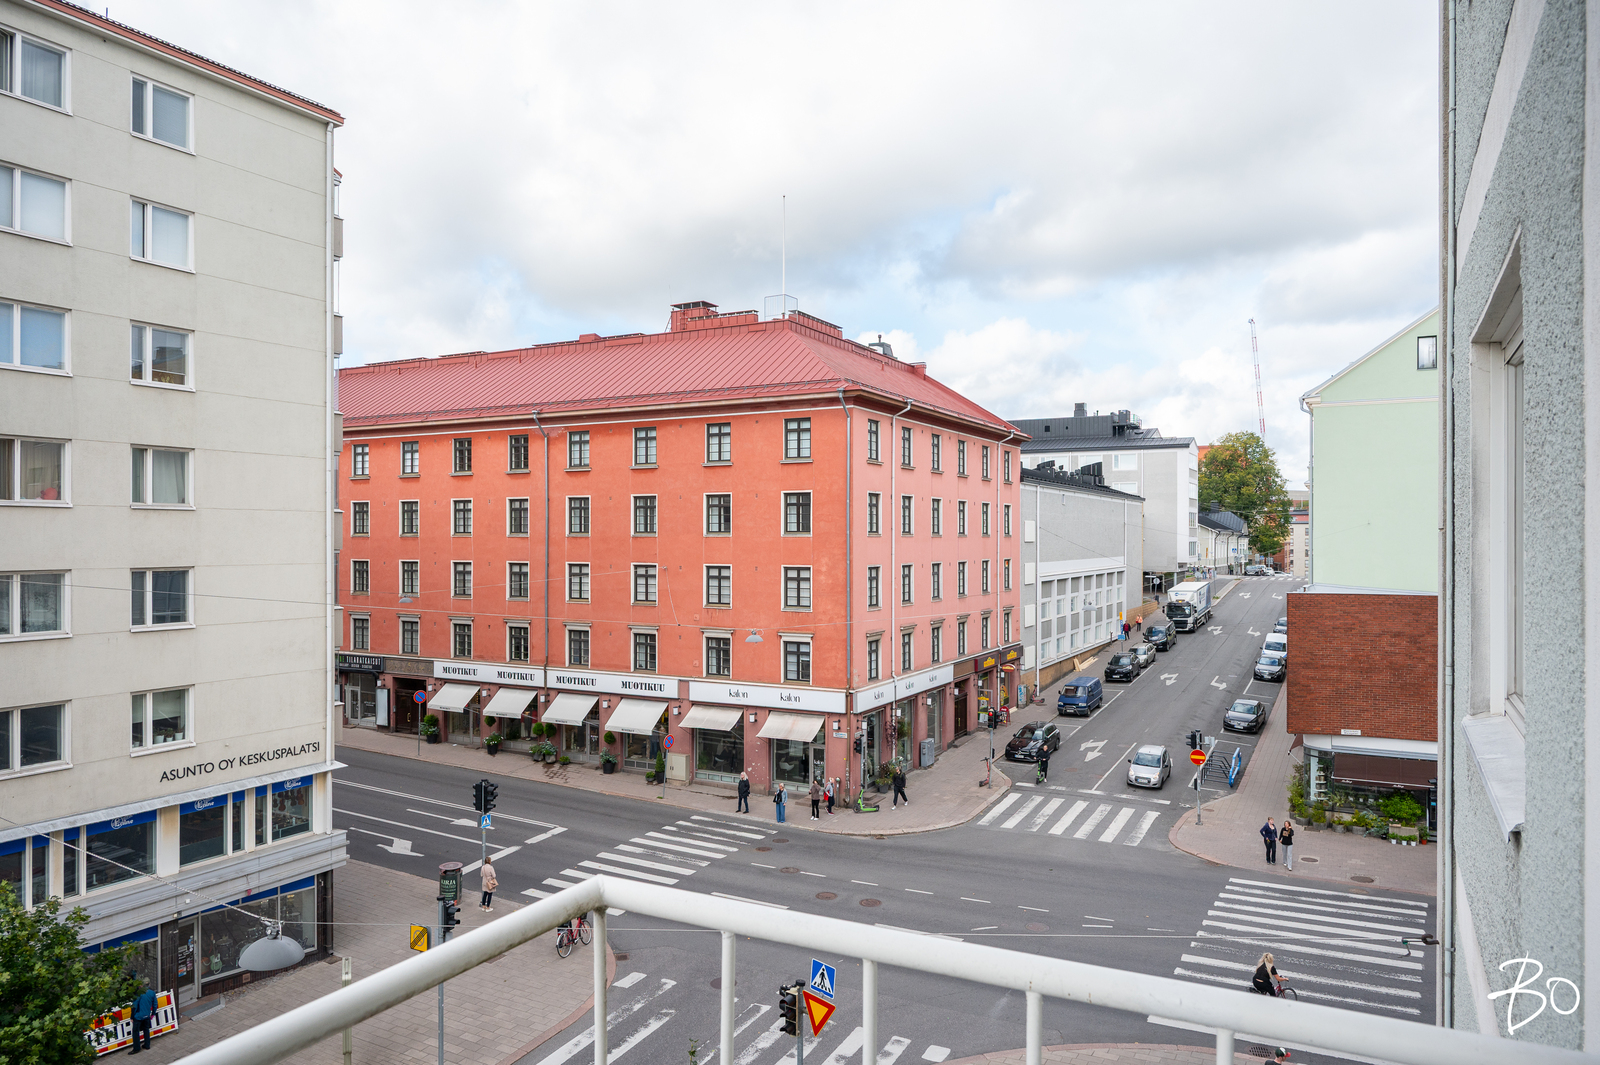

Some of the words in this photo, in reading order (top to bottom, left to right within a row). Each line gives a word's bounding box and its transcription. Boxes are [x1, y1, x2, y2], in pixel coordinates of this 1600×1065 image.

[442, 666, 478, 676] MUOTIKUU
[497, 671, 535, 681] MUOTIKUU
[556, 676, 597, 686] MUOTIKUU
[621, 681, 665, 692] MUOTIKUU
[729, 689, 748, 698] kalon
[780, 693, 801, 702] kalon
[159, 763, 215, 783] ASUNTO
[218, 758, 236, 770] OY
[239, 741, 320, 767] KESKUSPALATSI
